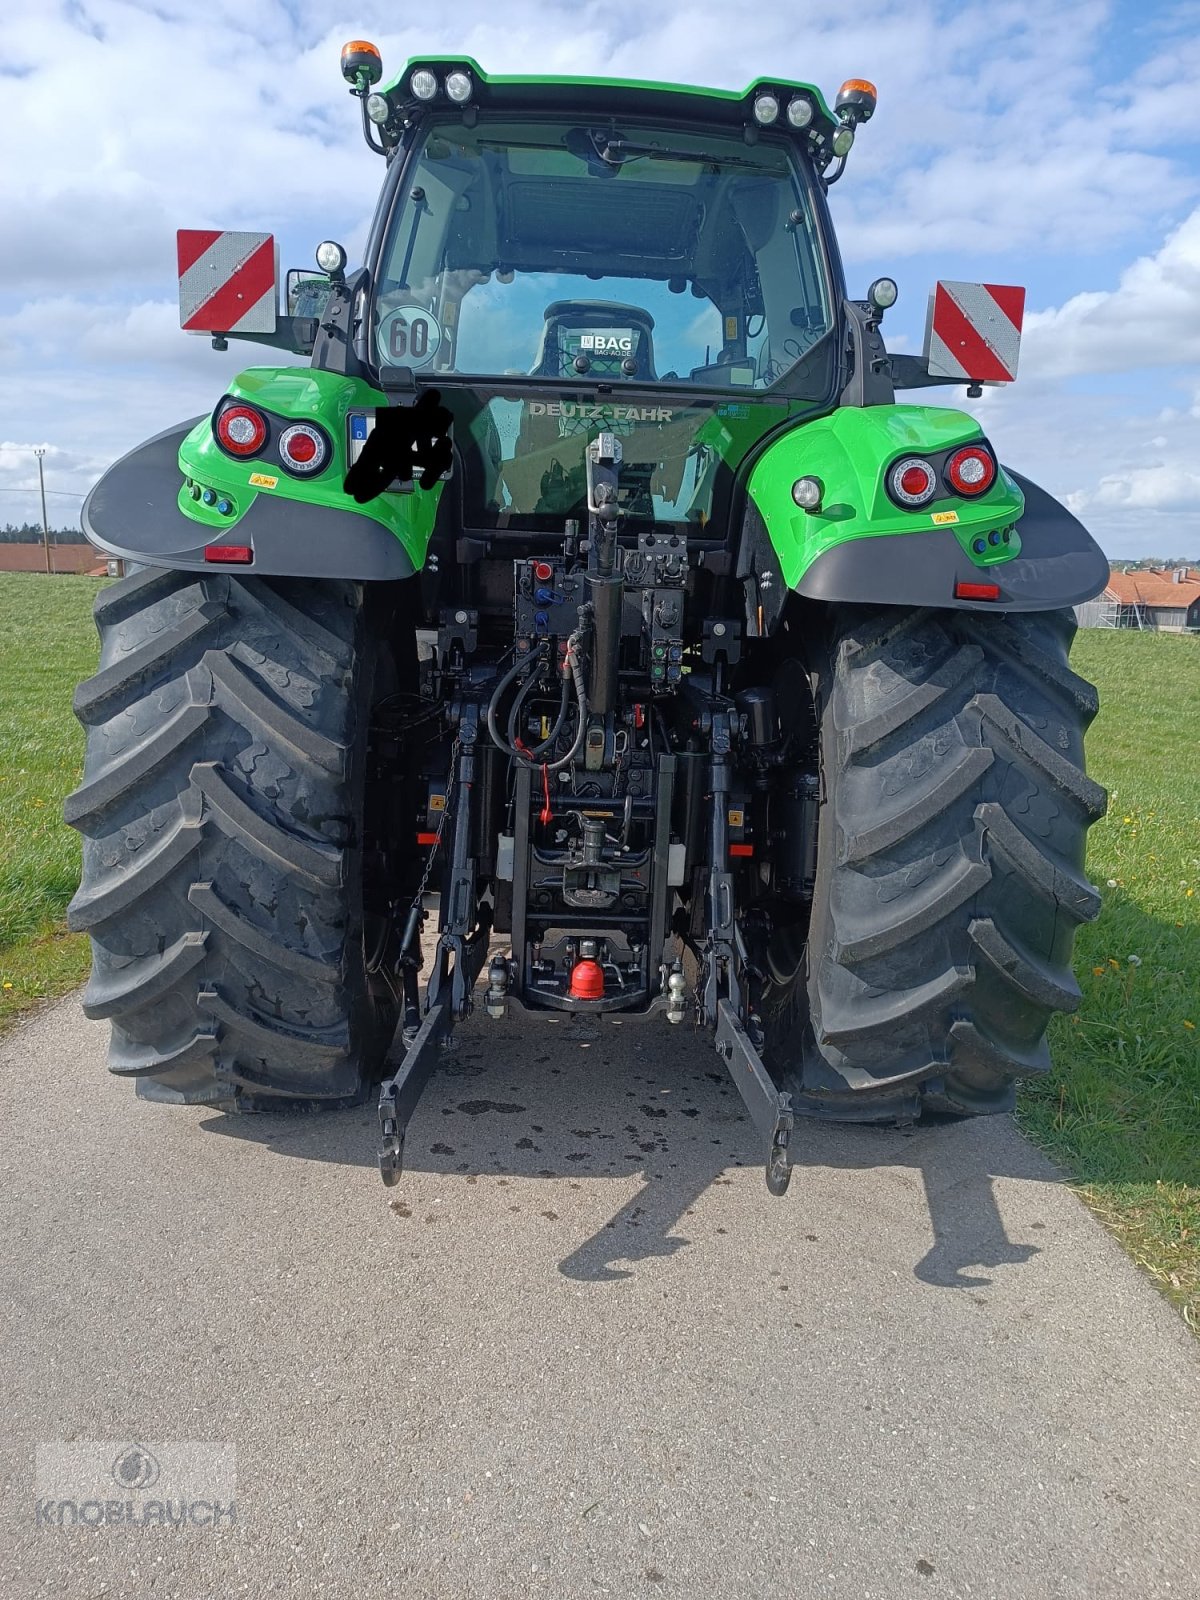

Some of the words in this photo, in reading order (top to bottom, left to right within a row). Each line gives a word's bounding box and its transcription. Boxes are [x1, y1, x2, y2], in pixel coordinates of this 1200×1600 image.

[390, 317, 429, 358] 60
[595, 336, 632, 350] BAG
[529, 402, 673, 422] DEUTZ-FAHR
